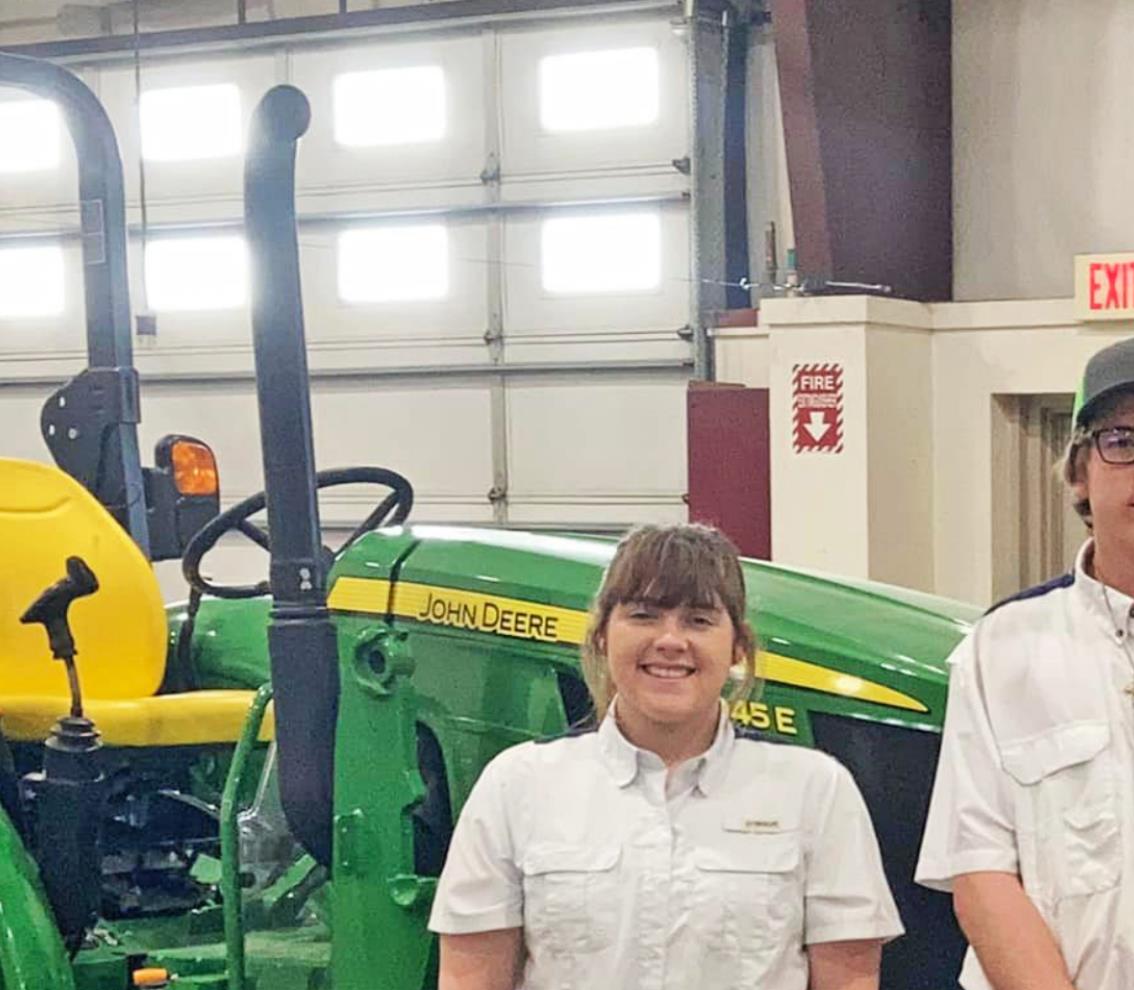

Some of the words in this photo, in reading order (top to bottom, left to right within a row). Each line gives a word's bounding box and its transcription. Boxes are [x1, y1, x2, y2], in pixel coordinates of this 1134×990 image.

[800, 375, 835, 390] FIRE
[419, 592, 477, 625] JOHN
[482, 602, 559, 638] DEERE
